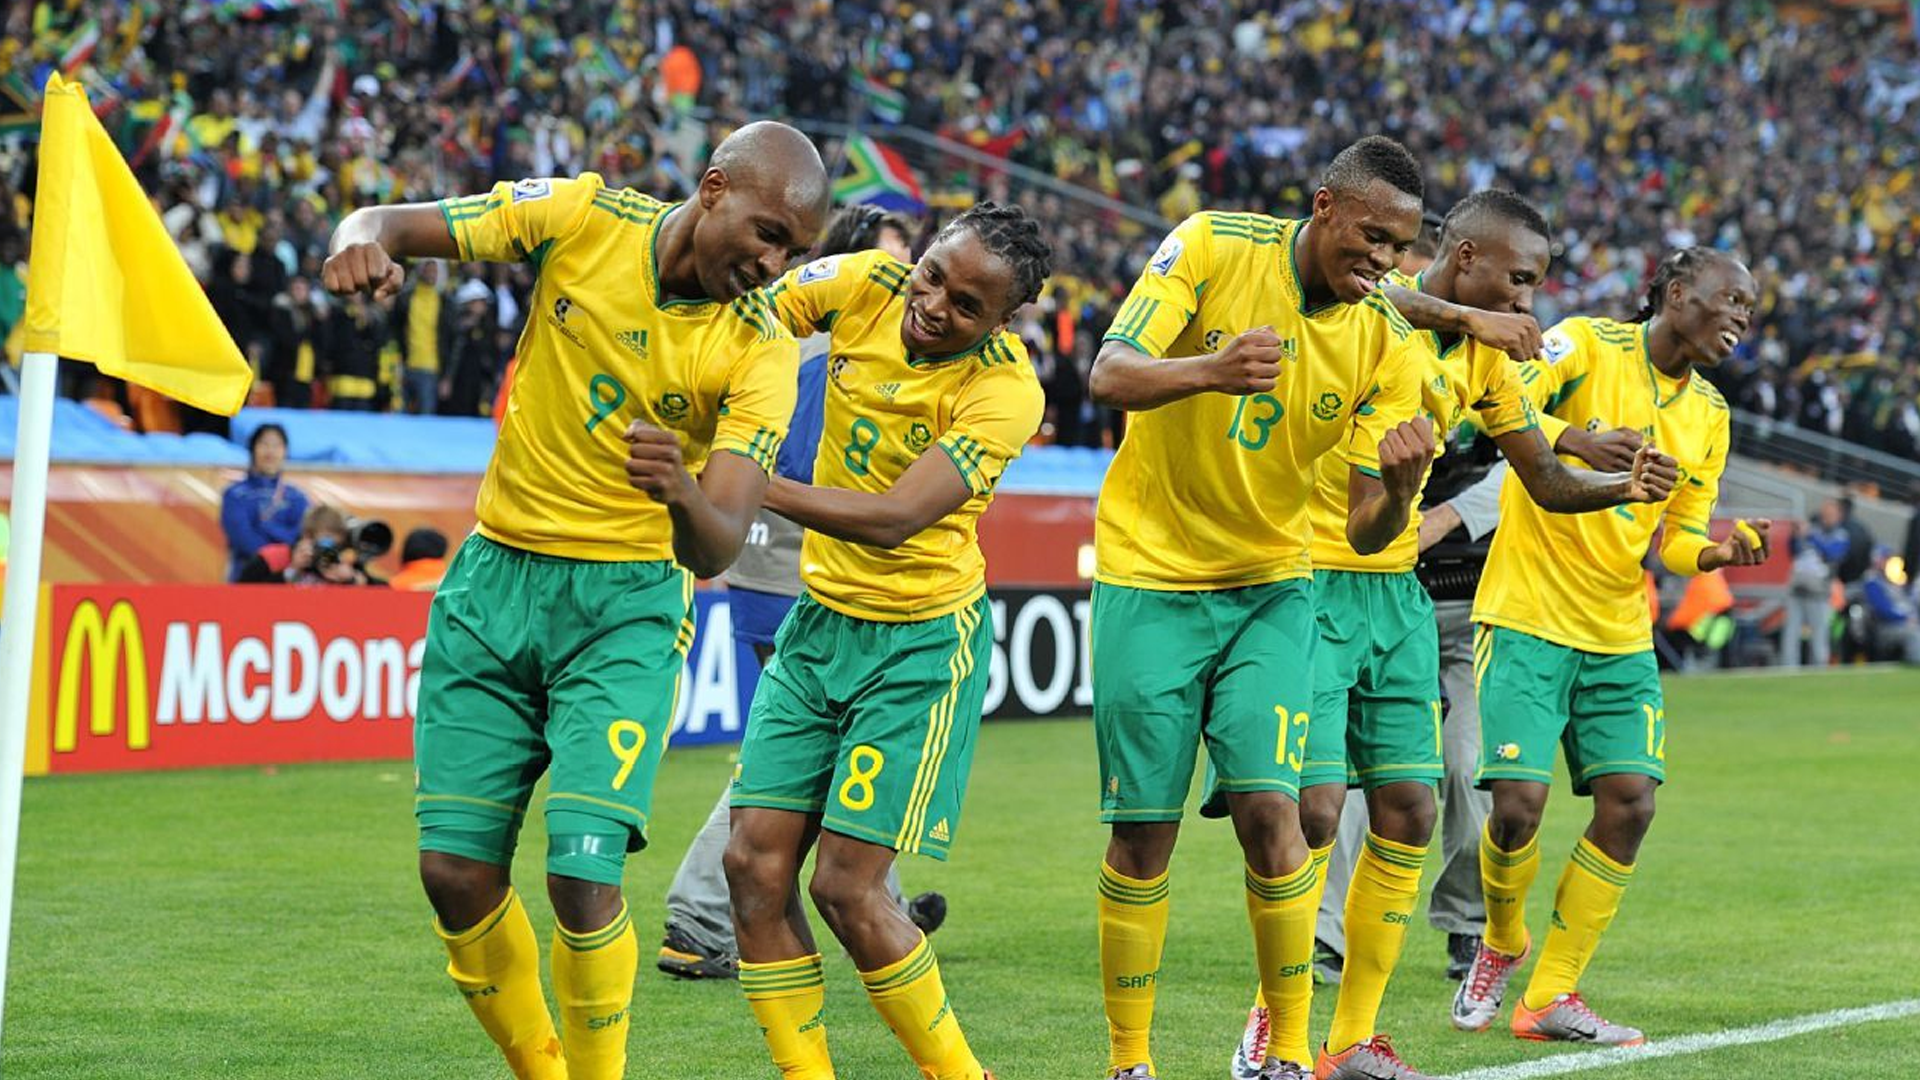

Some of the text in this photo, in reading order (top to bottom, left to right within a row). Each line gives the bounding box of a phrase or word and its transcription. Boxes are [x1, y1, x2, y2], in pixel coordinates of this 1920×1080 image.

[585, 374, 625, 434] 9
[1229, 393, 1284, 451] 13
[845, 417, 880, 476] 8
[608, 720, 646, 790] 9
[1275, 705, 1309, 773] 13
[839, 745, 884, 811] 8
